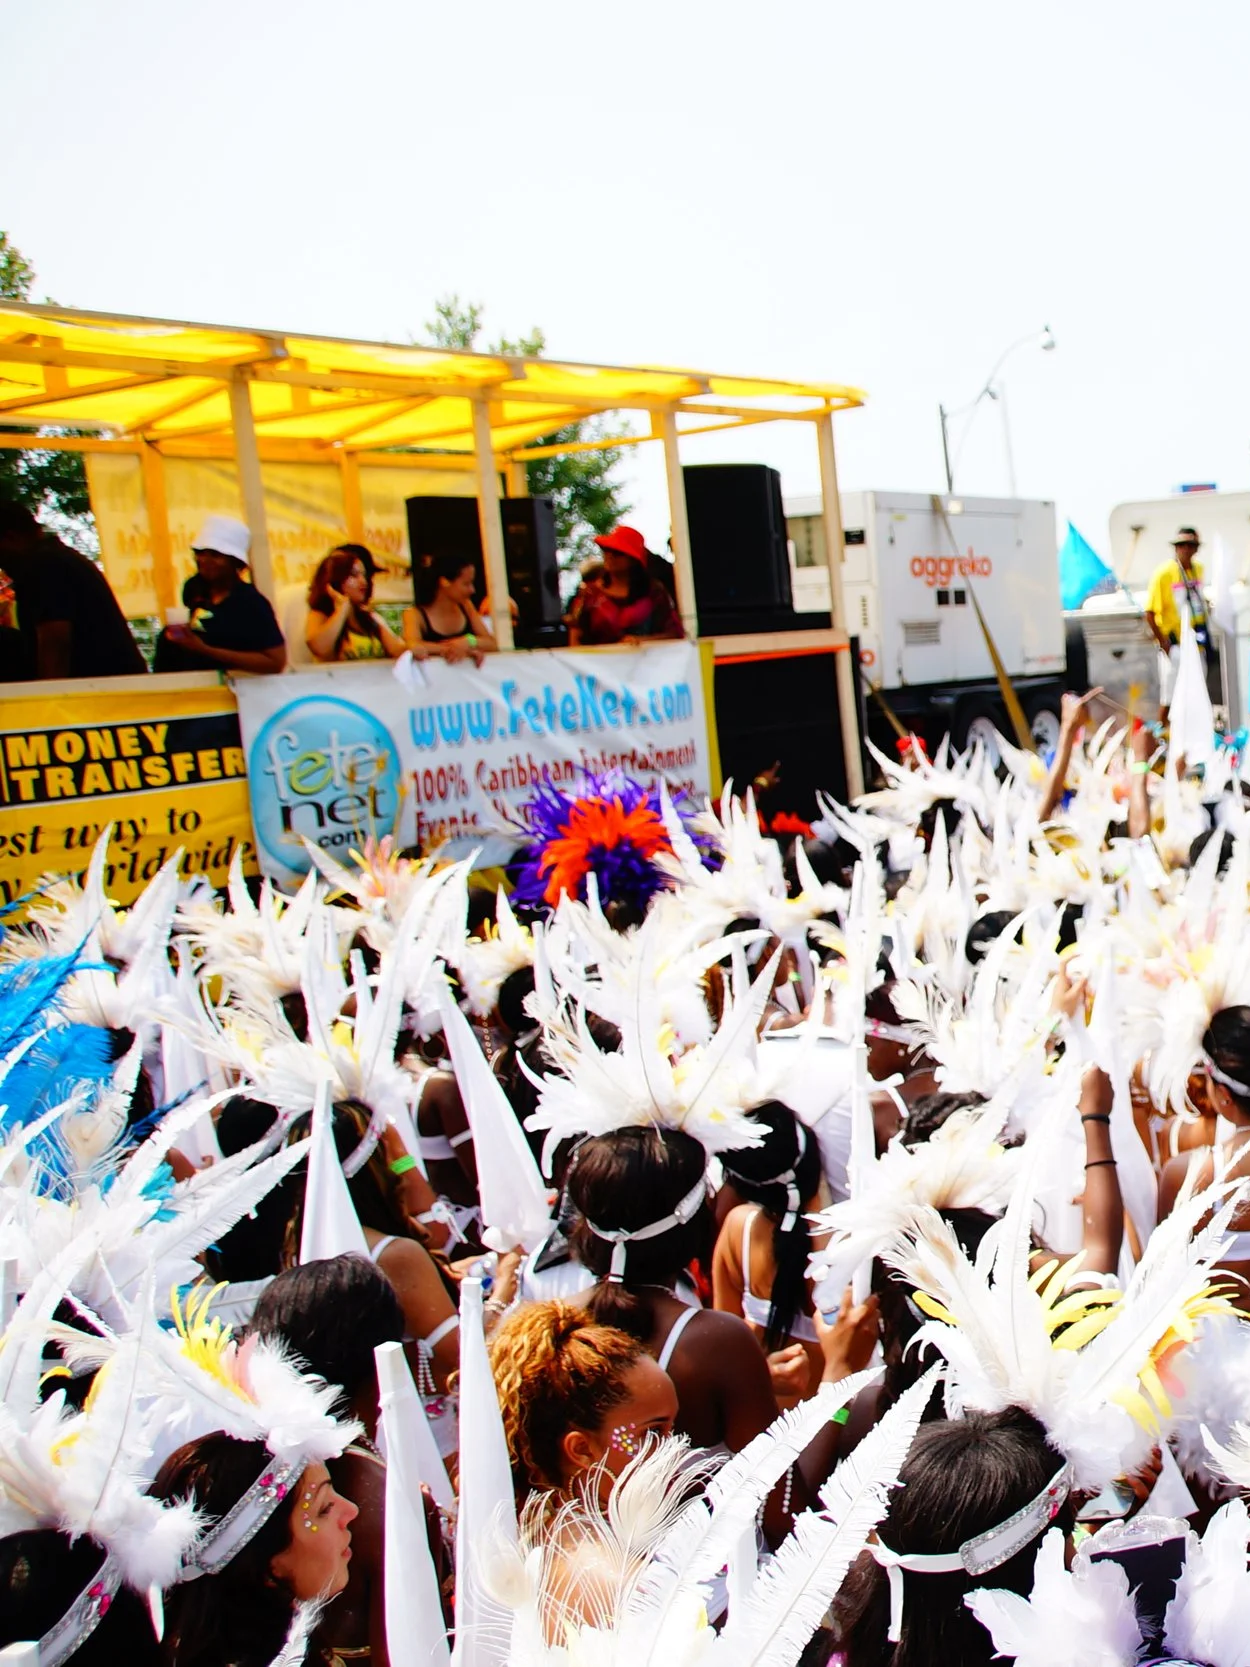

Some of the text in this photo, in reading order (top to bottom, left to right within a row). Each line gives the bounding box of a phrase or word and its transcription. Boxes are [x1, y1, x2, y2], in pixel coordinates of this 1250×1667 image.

[5, 723, 170, 768] MONEY
[263, 729, 381, 804] fete
[10, 746, 247, 801] TRANSFER
[411, 763, 469, 804] 100%
[475, 752, 577, 793] Caribbean
[168, 808, 202, 835] to
[280, 787, 390, 833] net
